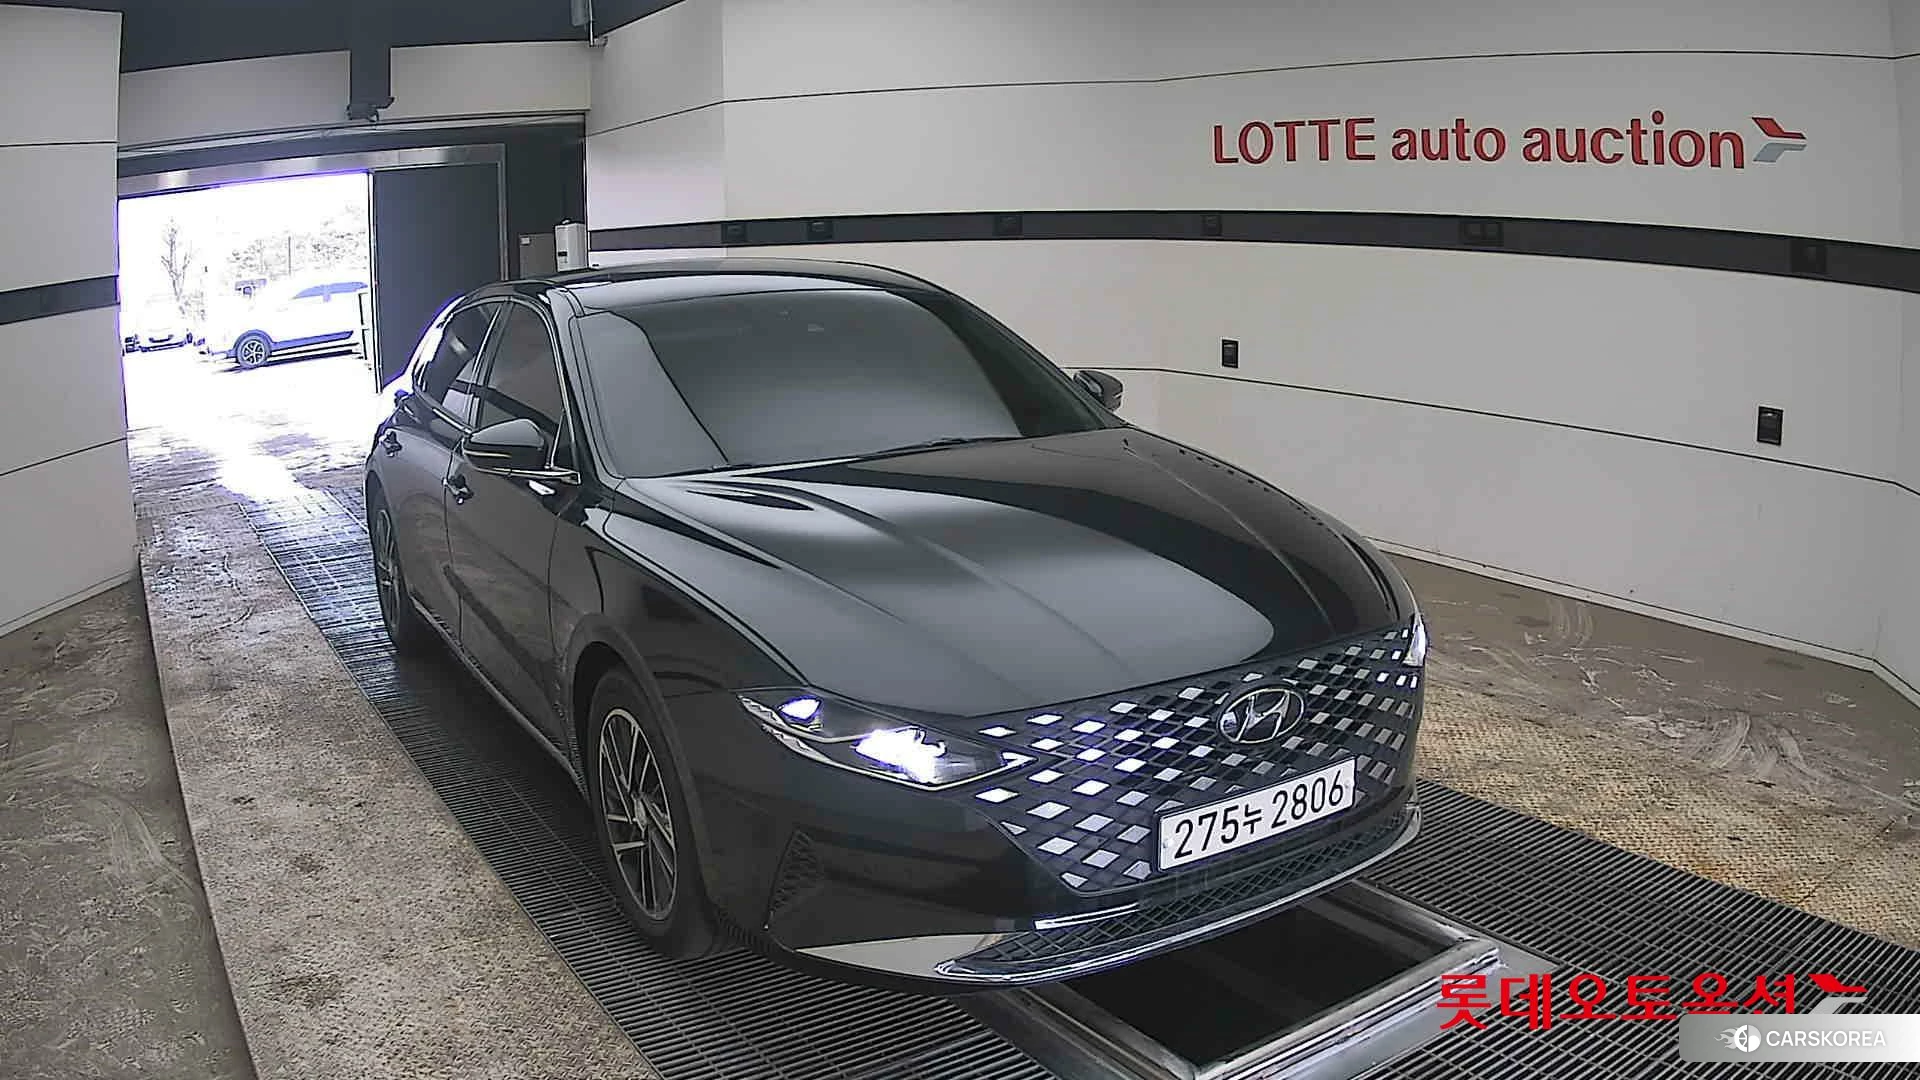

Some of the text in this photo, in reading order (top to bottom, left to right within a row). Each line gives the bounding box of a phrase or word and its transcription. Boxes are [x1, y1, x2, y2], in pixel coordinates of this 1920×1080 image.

[1213, 110, 1745, 169] LOTTE auto auction
[1174, 769, 1344, 859] 275누 2806
